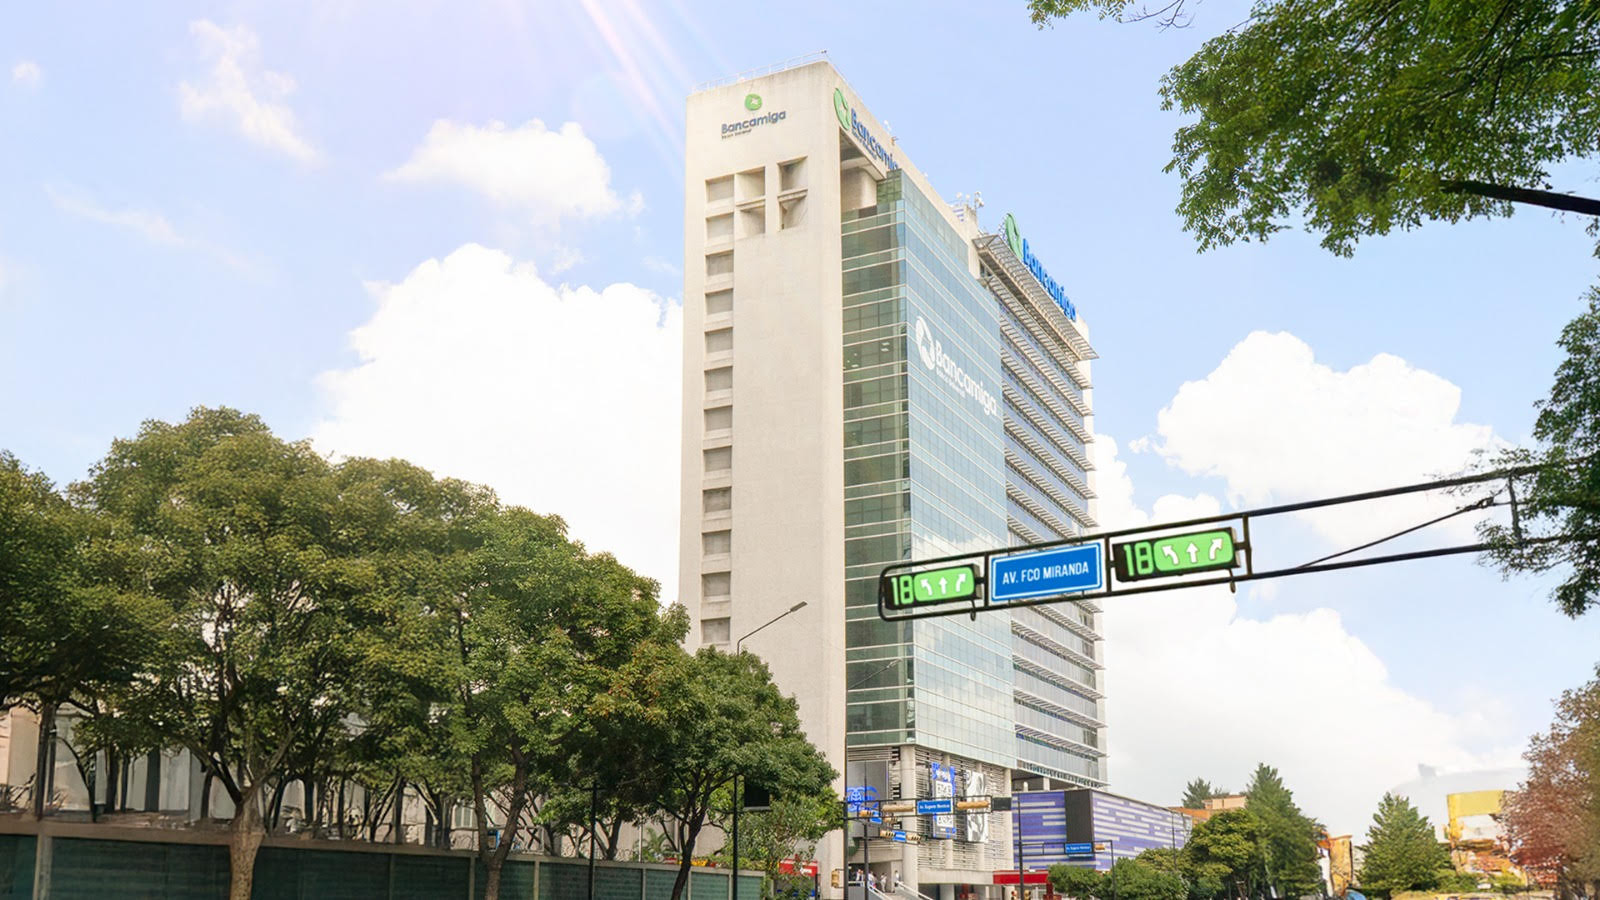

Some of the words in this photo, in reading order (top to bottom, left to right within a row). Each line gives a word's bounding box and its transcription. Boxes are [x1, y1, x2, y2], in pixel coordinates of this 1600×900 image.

[721, 111, 786, 134] Bancamiga
[851, 108, 899, 171] Bancami
[935, 340, 997, 416] Bancamiga
[1002, 571, 1019, 585] AV.
[1021, 568, 1041, 582] FCO
[1043, 561, 1089, 579] MIRANDA
[1123, 541, 1155, 577] 18
[891, 575, 915, 605] 18
